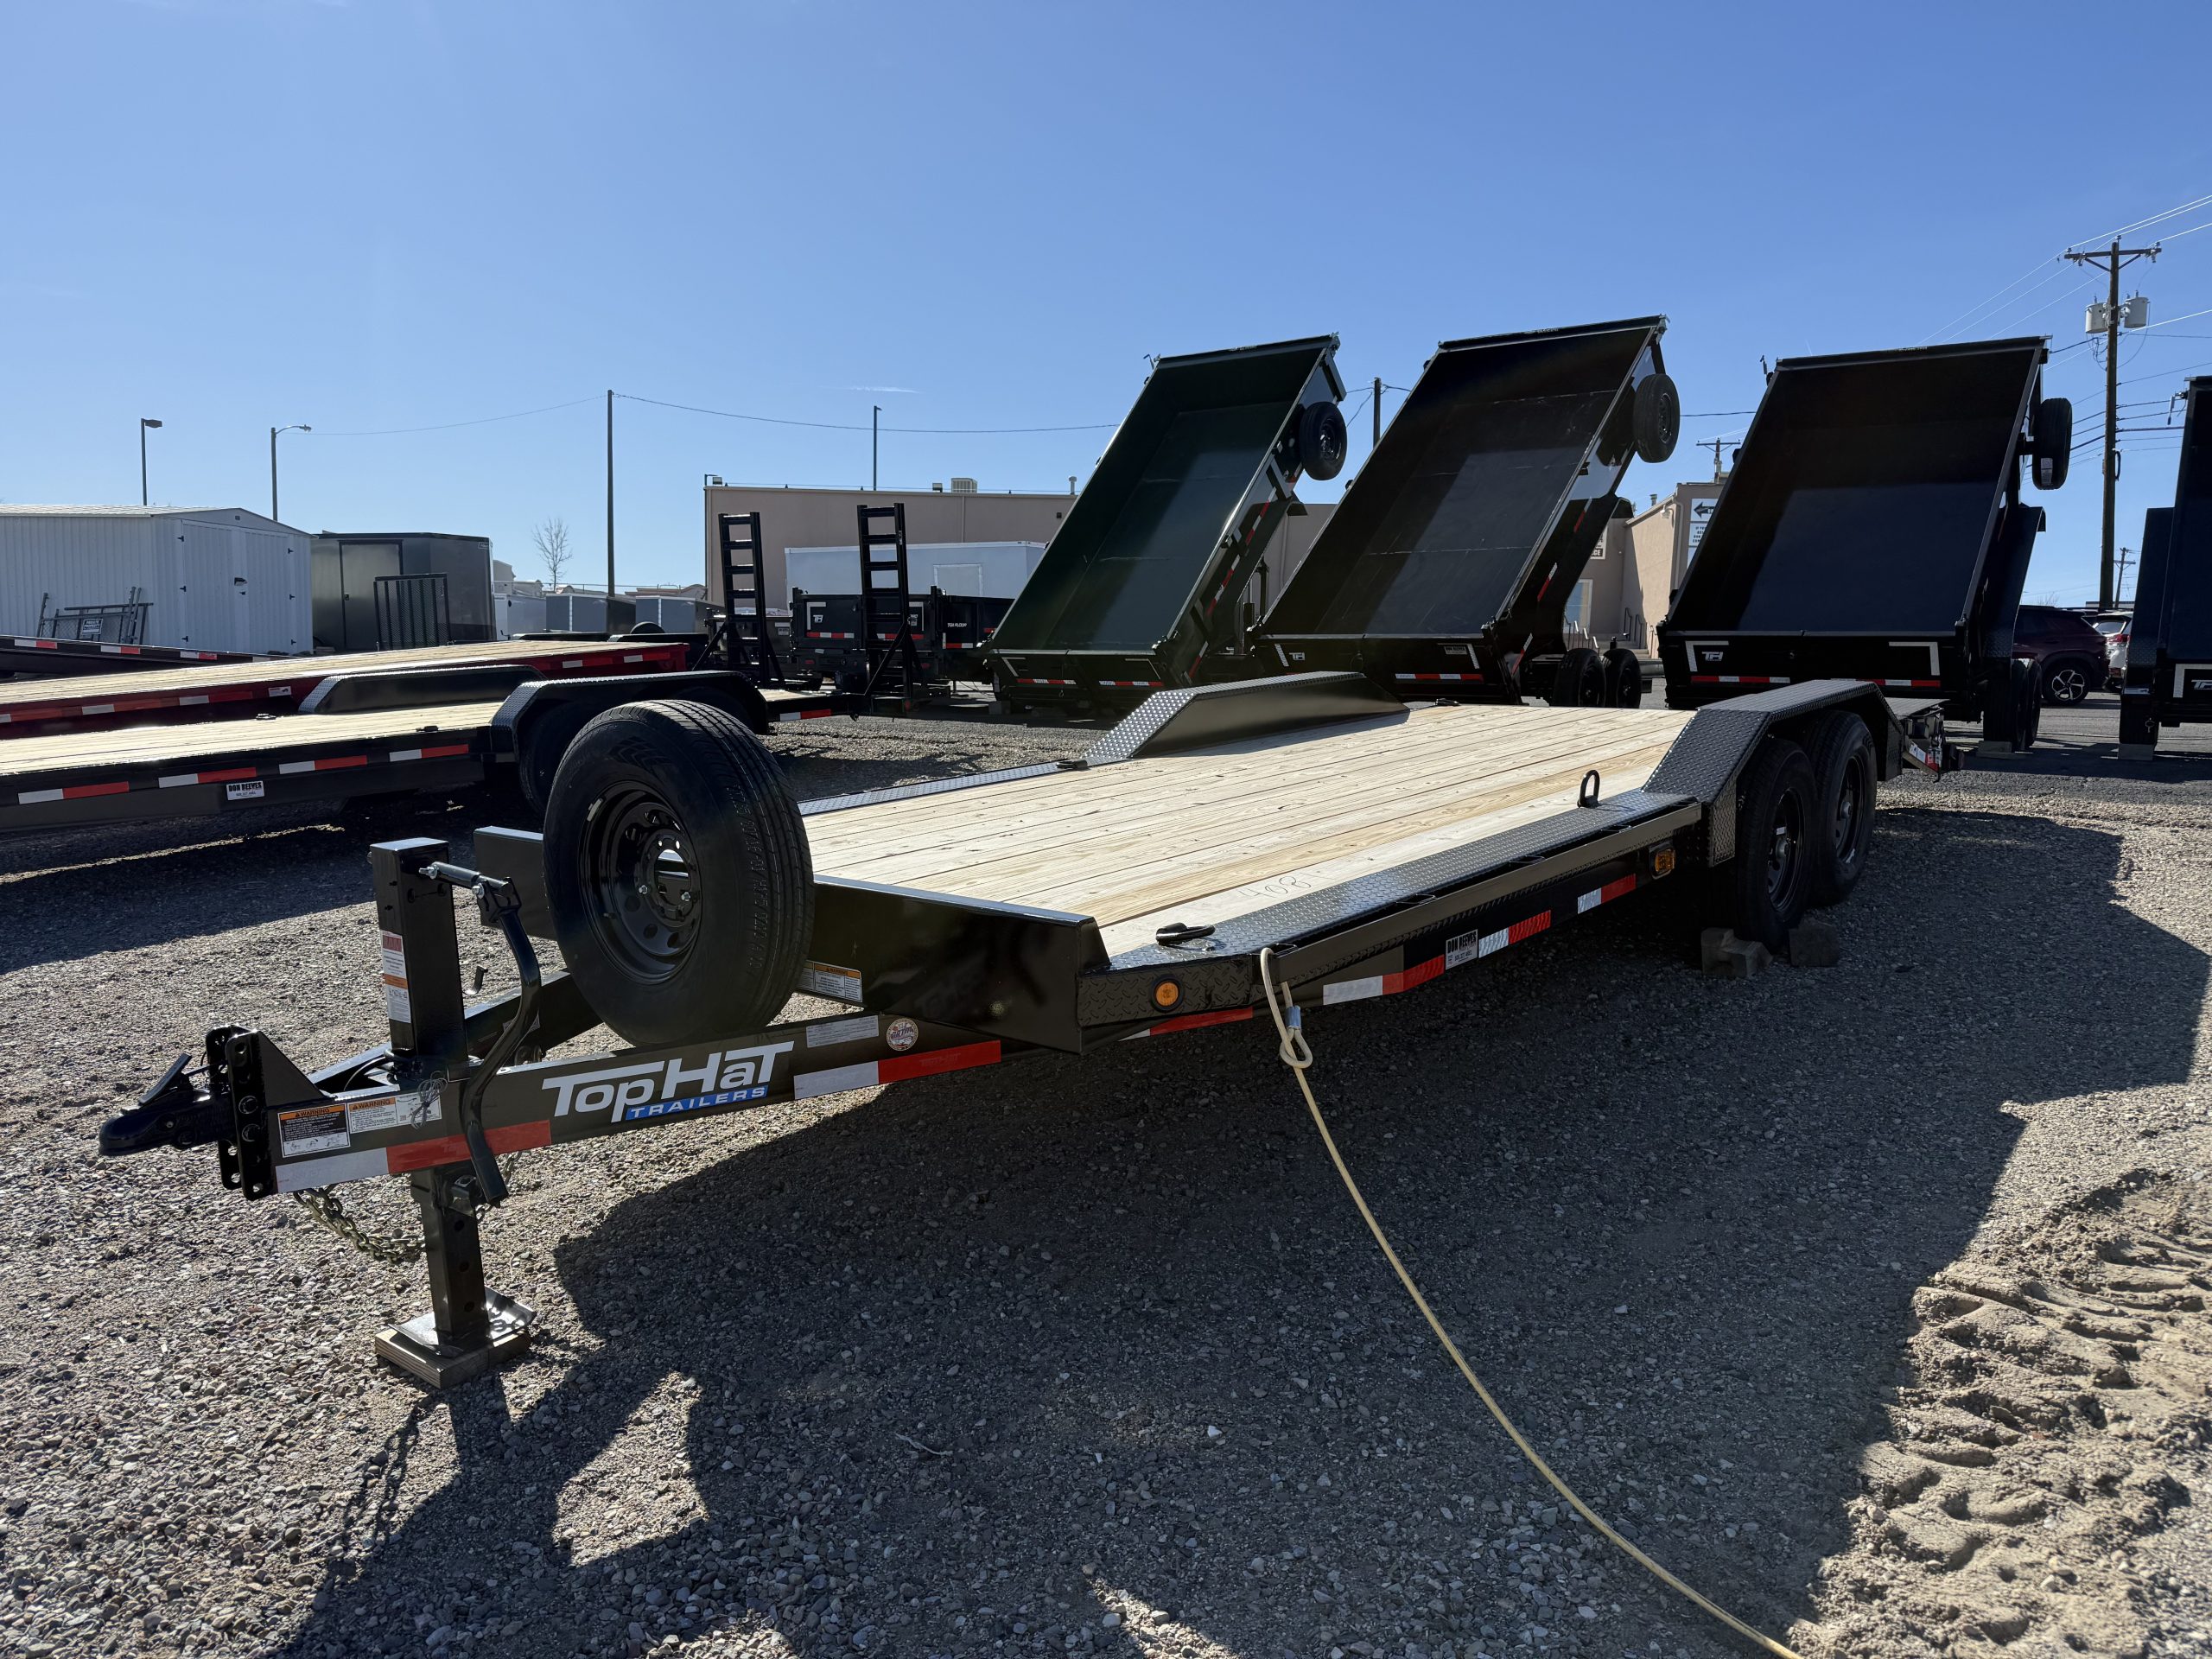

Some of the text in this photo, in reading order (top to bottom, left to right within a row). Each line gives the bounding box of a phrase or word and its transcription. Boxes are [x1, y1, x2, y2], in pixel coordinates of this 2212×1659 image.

[228, 781, 262, 792] DON REEVES
[1447, 931, 1477, 954] DON REEVES
[359, 1098, 391, 1110] WARNING
[630, 1086, 767, 1119] TRAILERS
[300, 1108, 330, 1117] WARNING
